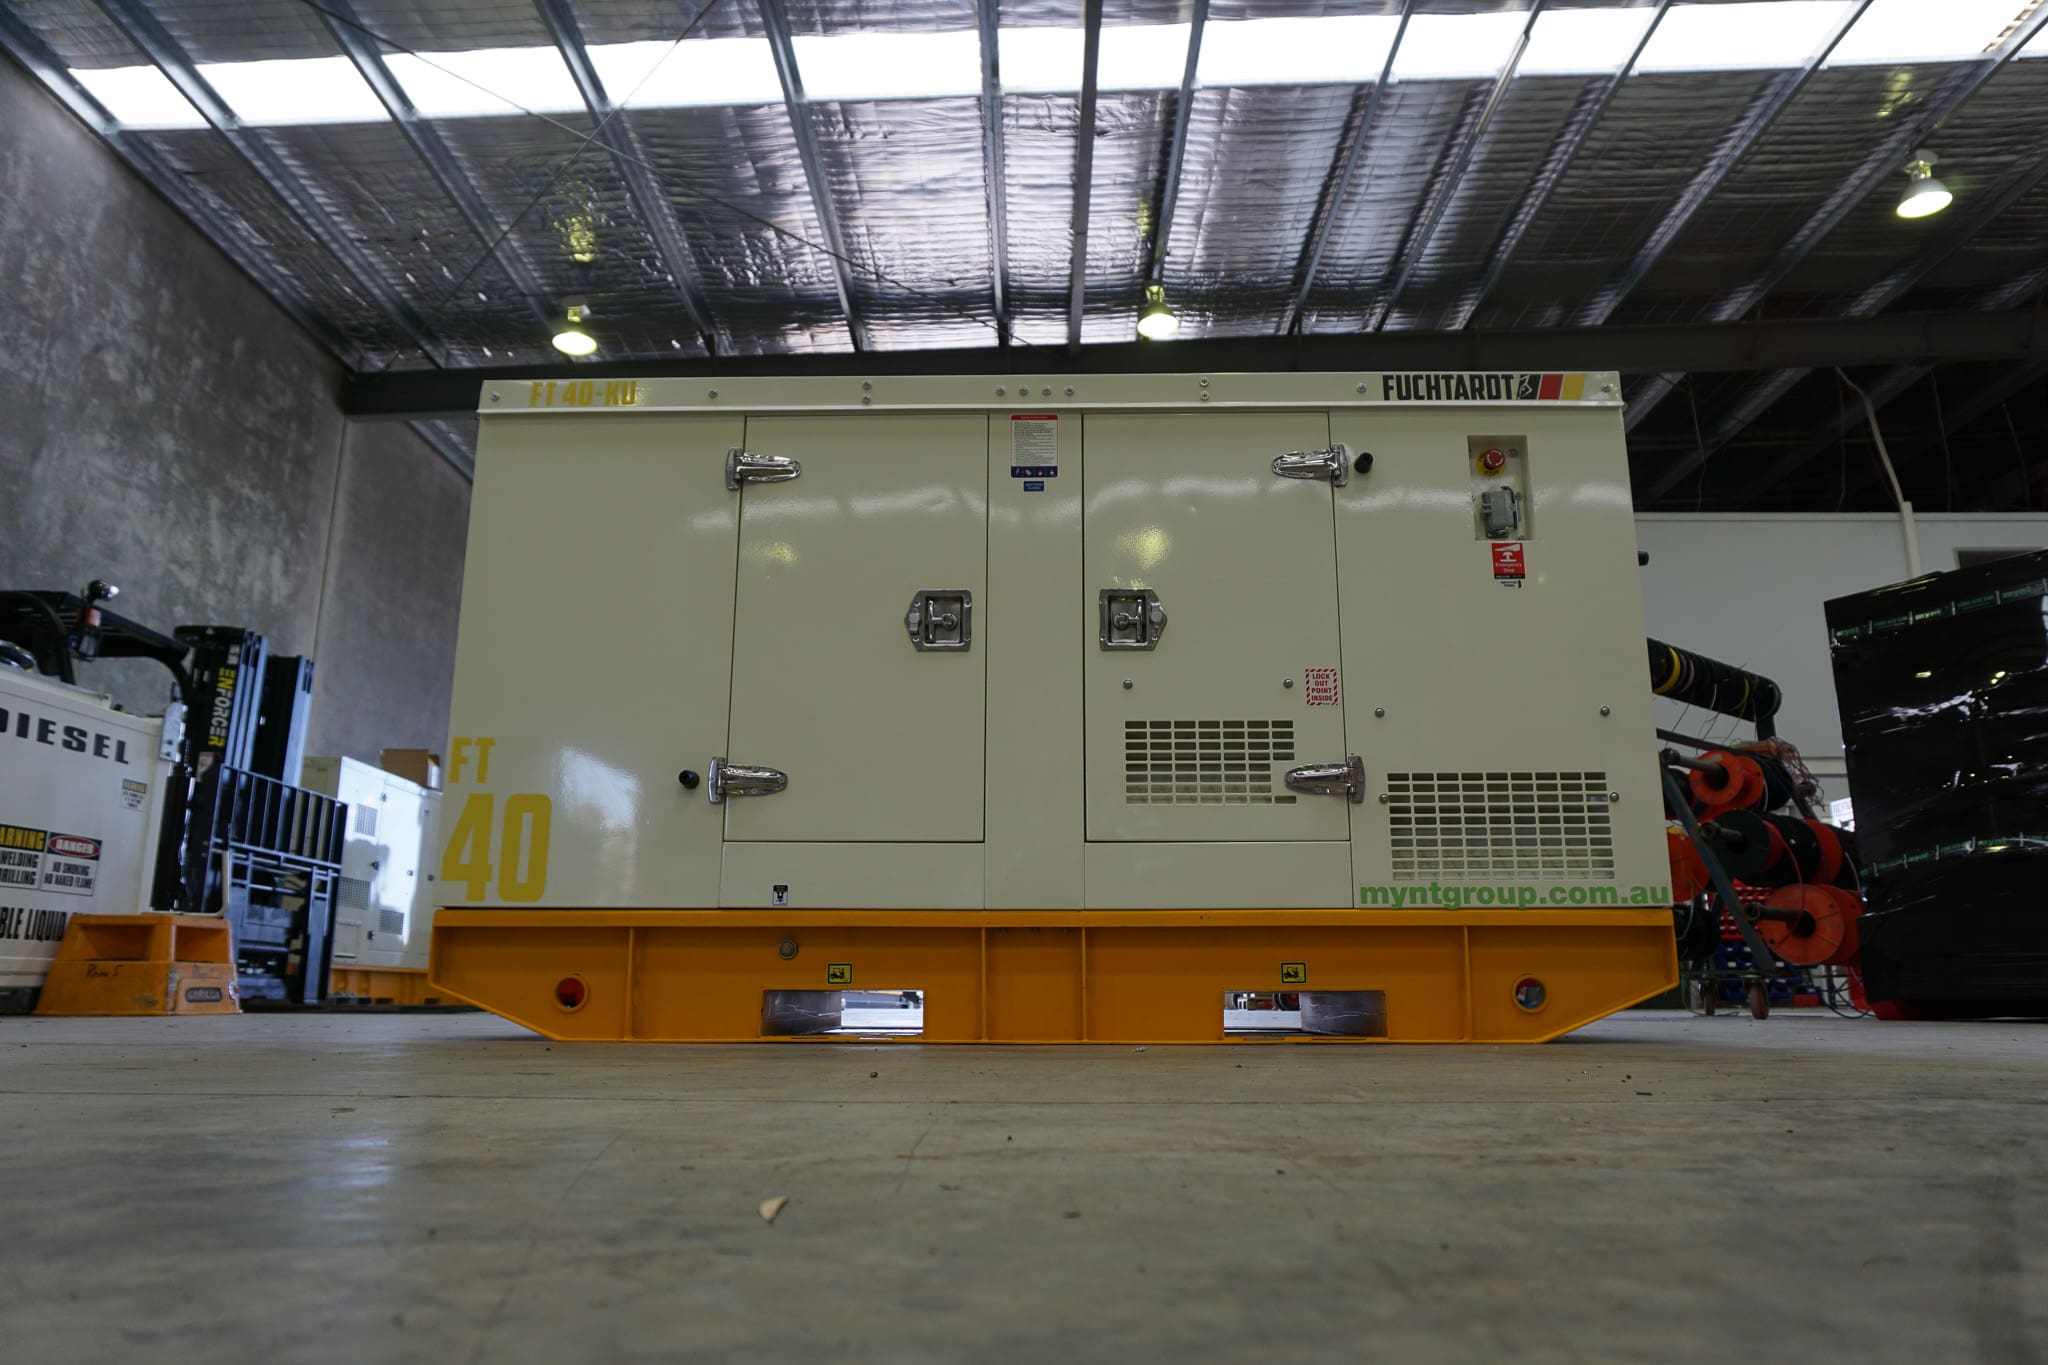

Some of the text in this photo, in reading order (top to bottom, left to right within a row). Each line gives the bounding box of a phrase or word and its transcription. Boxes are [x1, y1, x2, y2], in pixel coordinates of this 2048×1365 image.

[530, 381, 637, 407] FT 40-KU
[1382, 374, 1514, 400] FUCHTARDT
[208, 667, 237, 747] ENFORCER
[1311, 694, 1333, 702] INSIDE
[449, 737, 496, 784] FT
[56, 839, 95, 854] DANGER
[440, 793, 552, 902] 40
[43, 873, 53, 884] NO
[53, 861, 61, 873] NO
[1360, 882, 1670, 910] myntgroup.com.au
